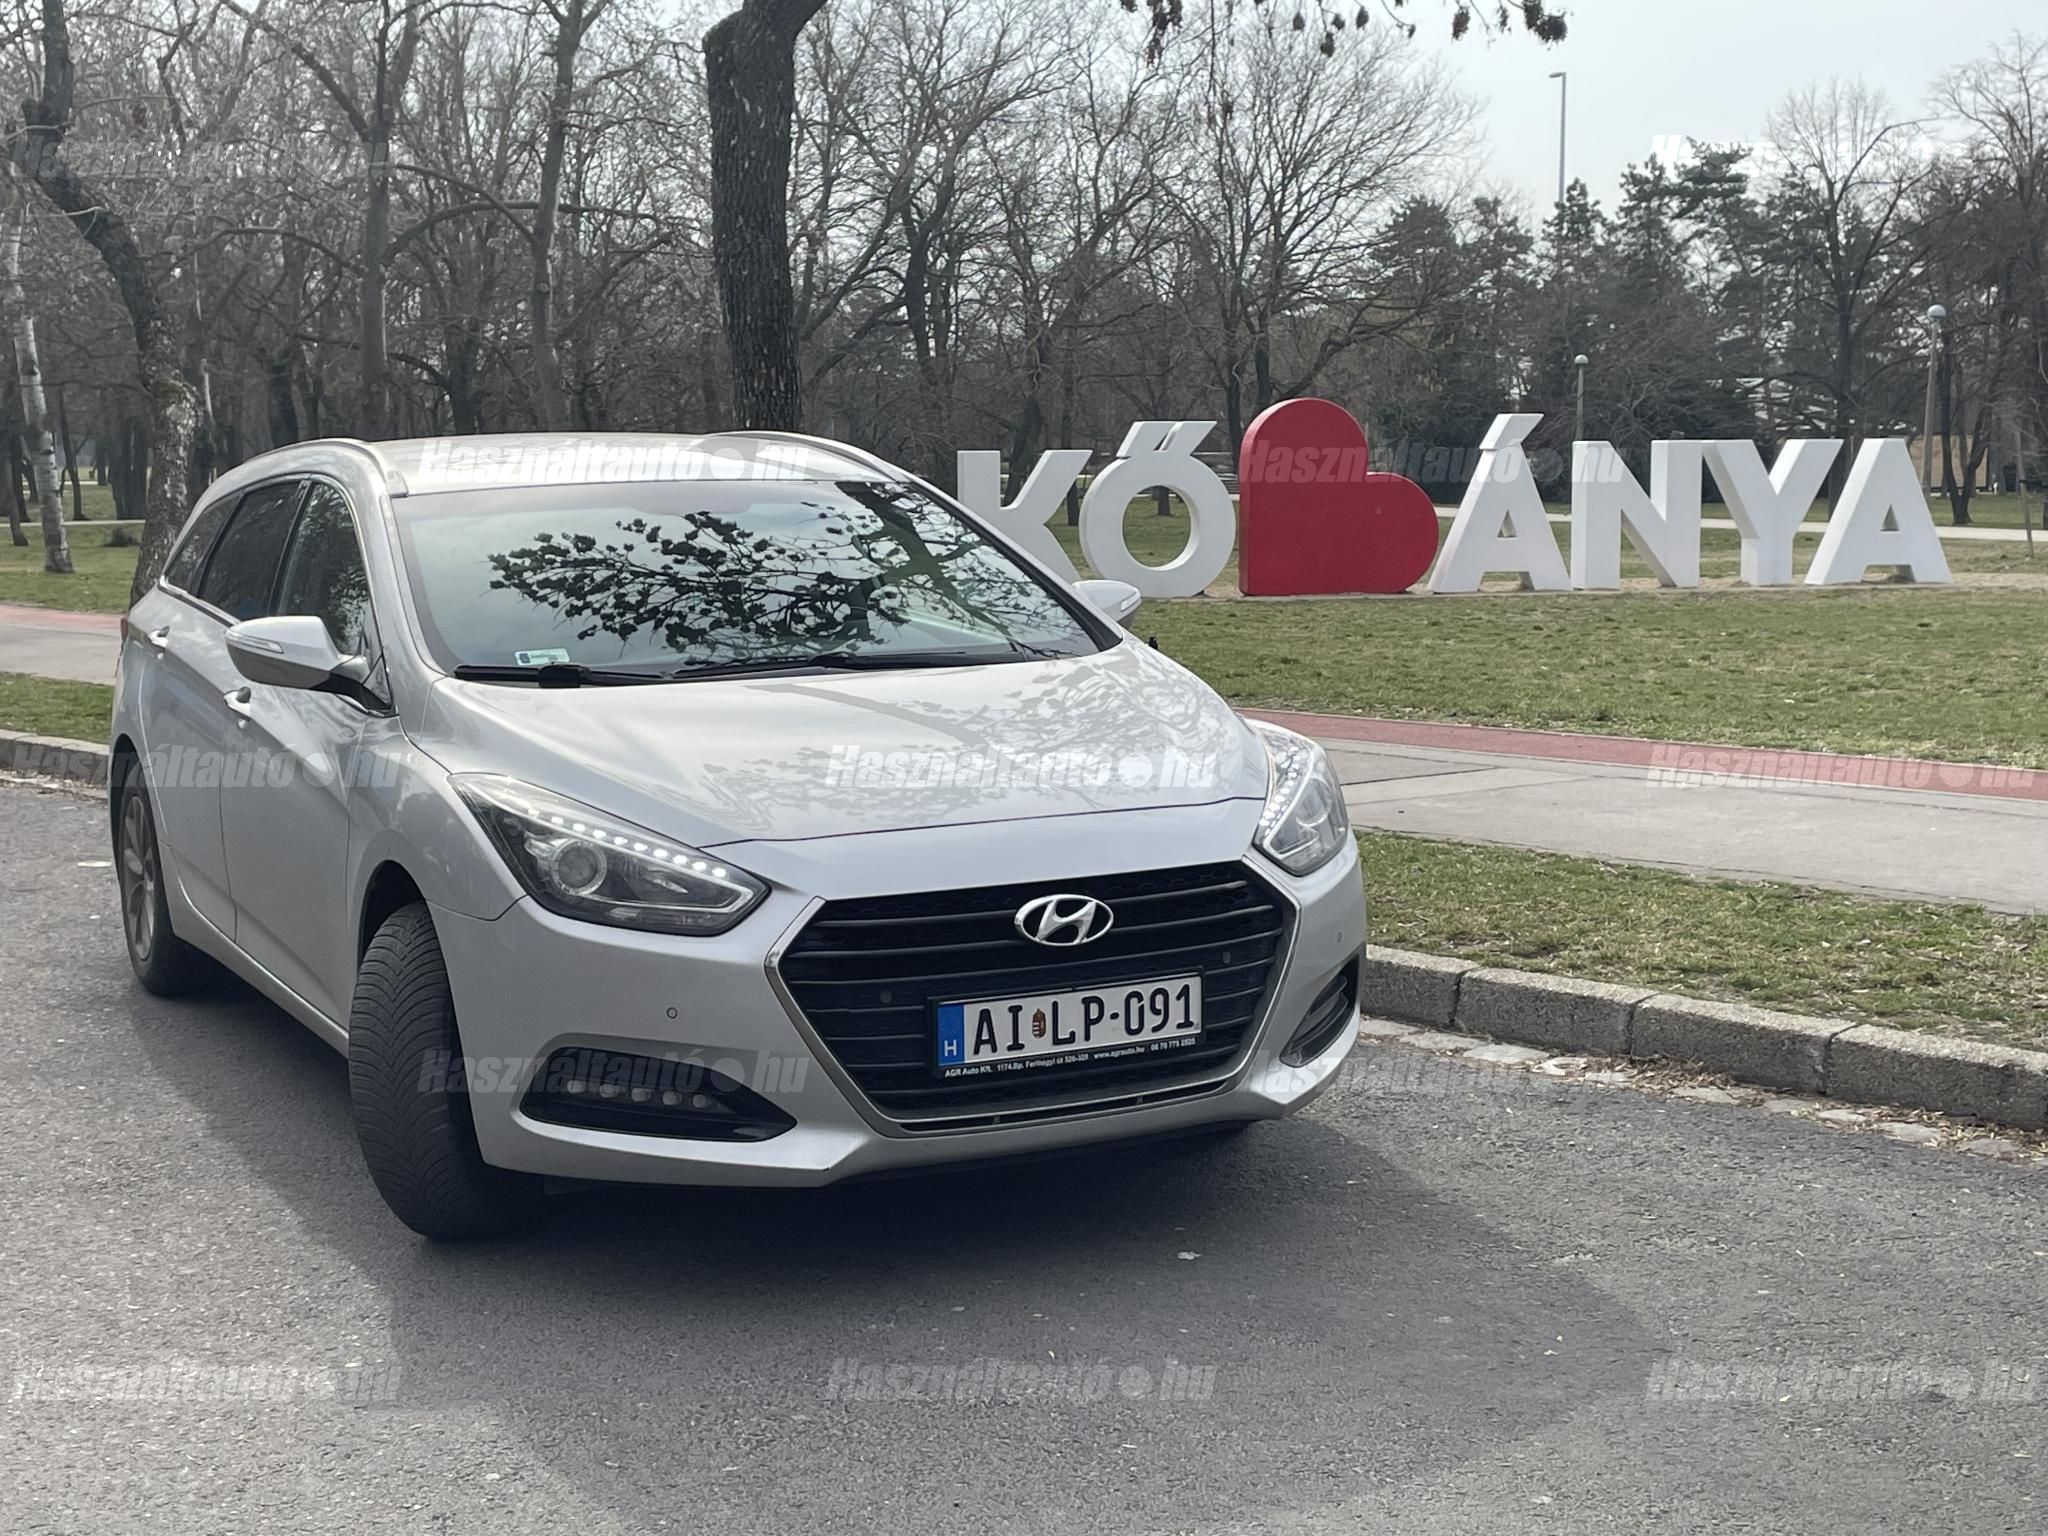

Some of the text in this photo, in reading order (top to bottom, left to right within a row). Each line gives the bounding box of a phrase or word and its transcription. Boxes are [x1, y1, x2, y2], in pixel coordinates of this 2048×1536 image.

[1427, 413, 1954, 593] ÁNYA
[944, 1039, 957, 1057] H
[945, 1069, 961, 1078] AGR
